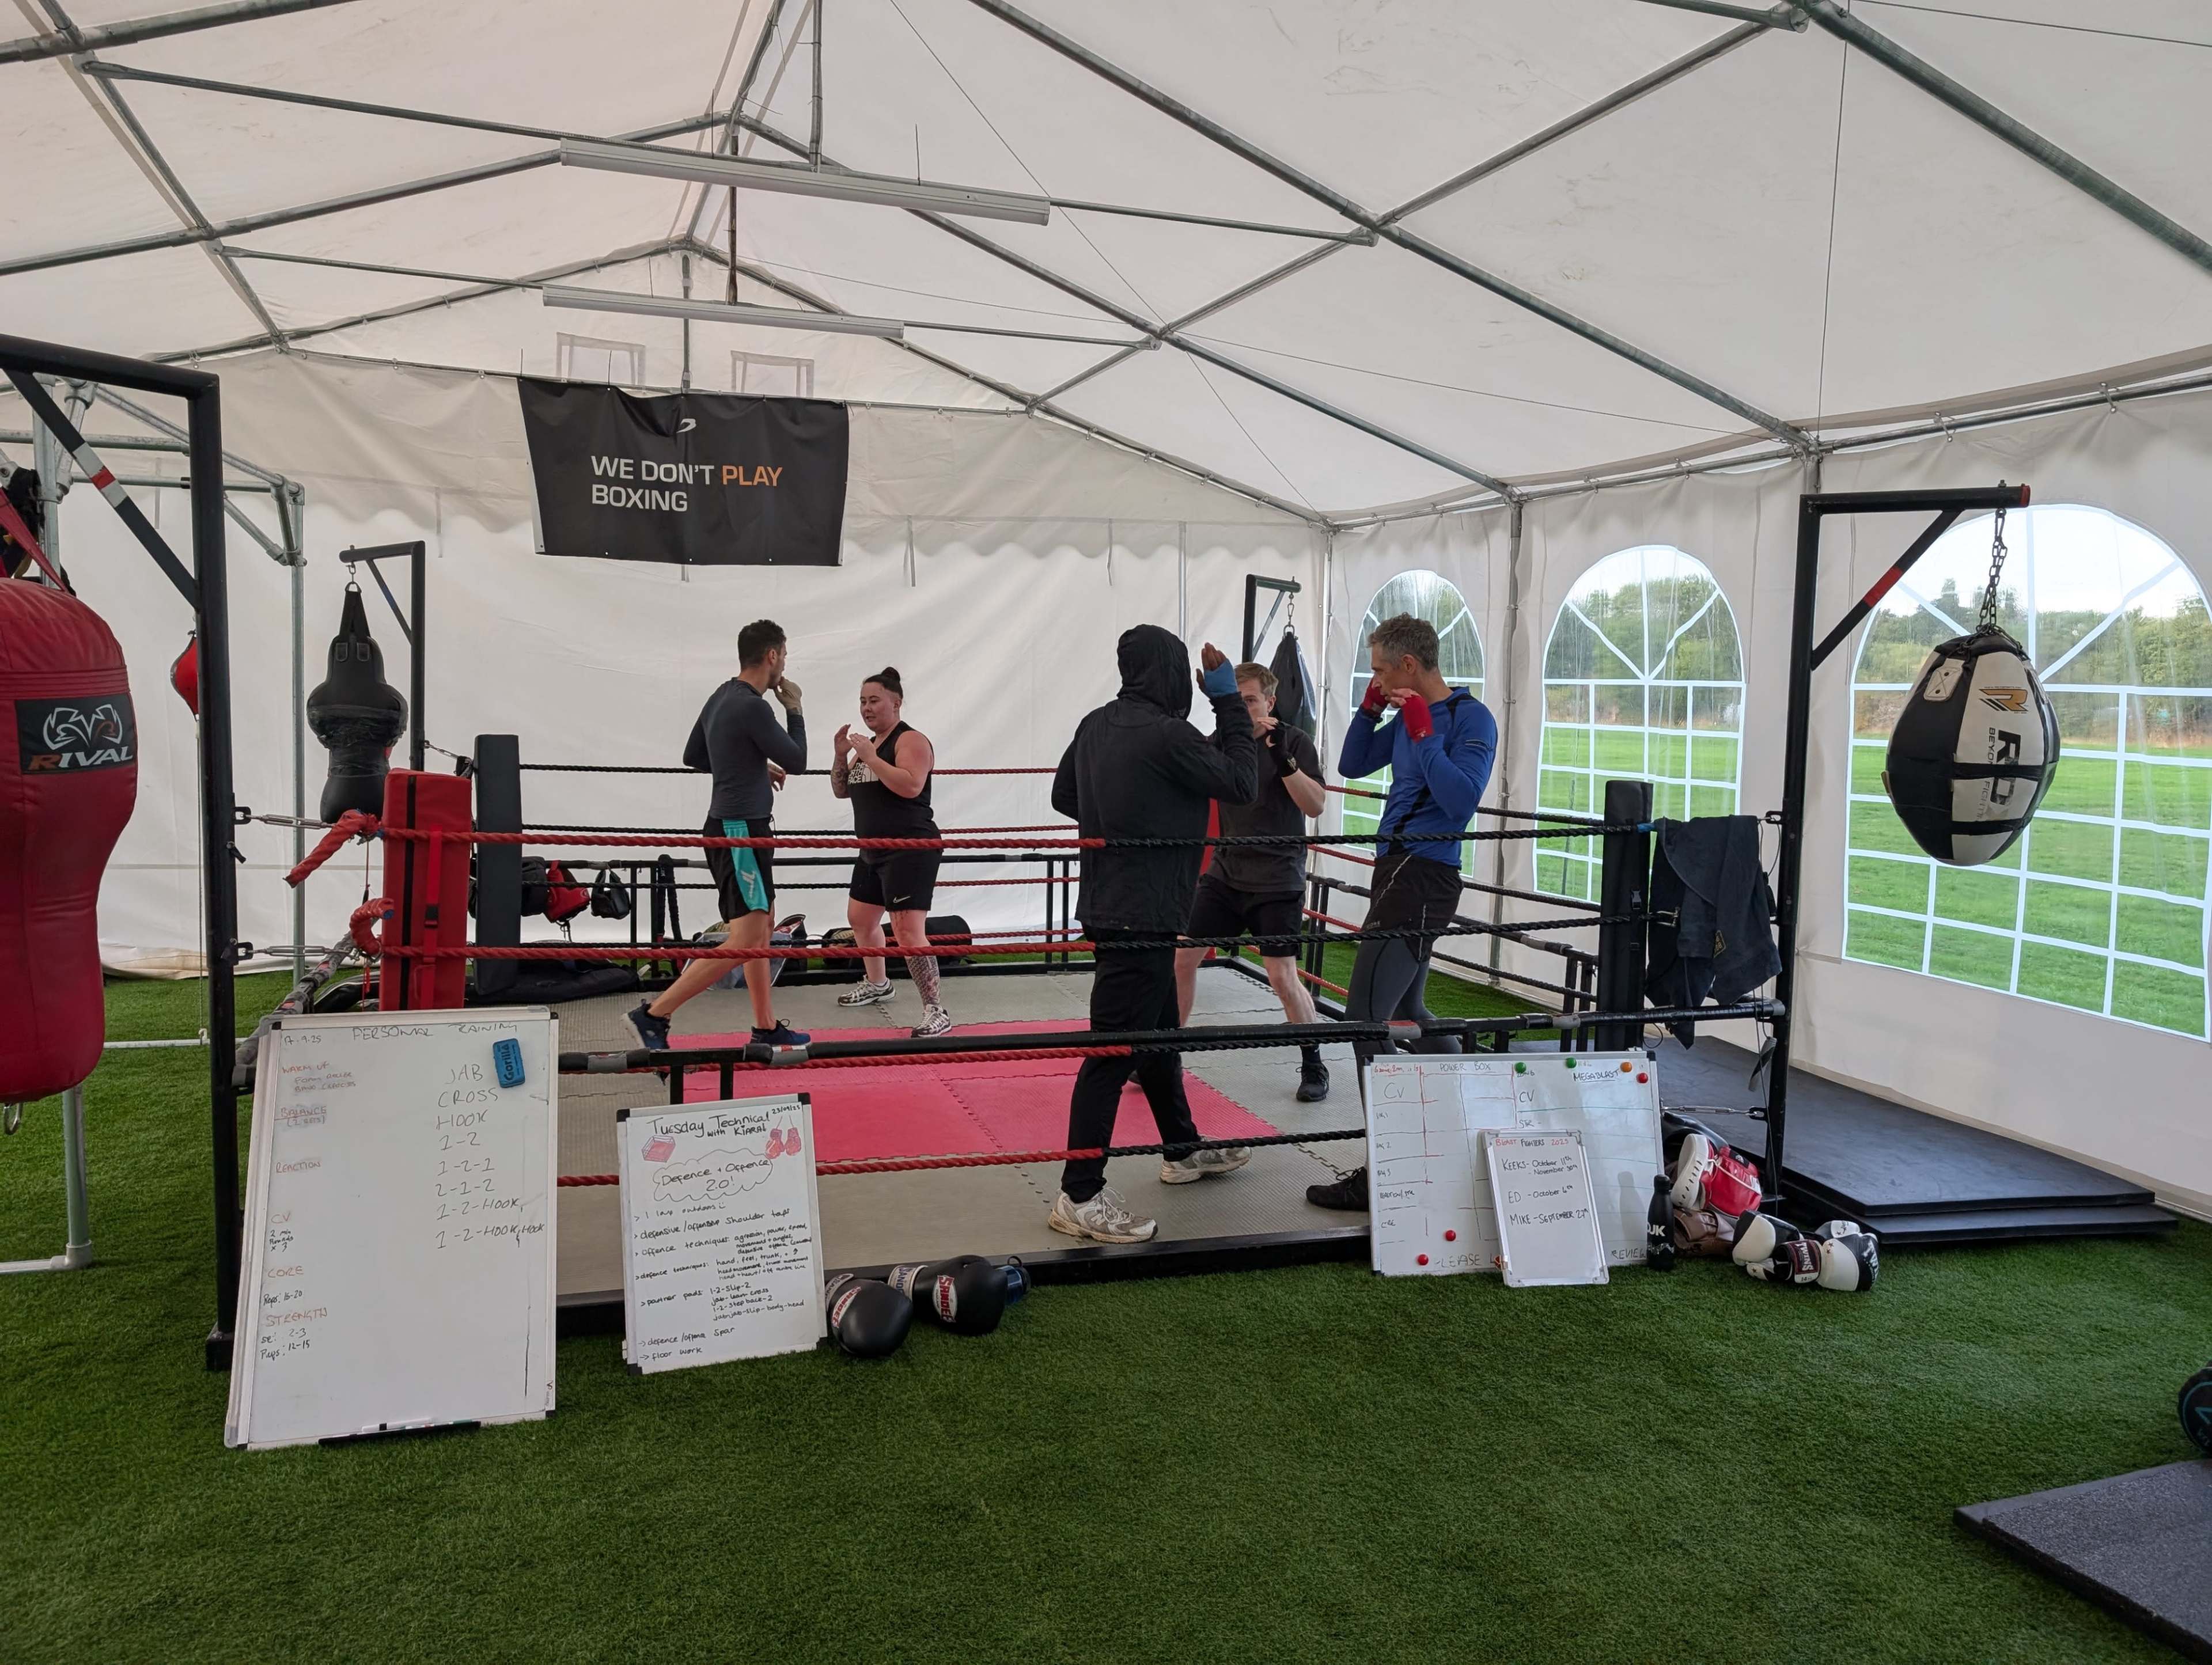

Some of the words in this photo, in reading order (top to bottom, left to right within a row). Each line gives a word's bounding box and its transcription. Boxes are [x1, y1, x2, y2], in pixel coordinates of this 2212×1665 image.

[590, 455, 634, 480] WE
[641, 460, 715, 486] DON'T
[721, 465, 783, 487] PLAY
[591, 483, 688, 512] BOXING
[28, 746, 134, 771] RIVAL
[501, 1043, 515, 1081] Gorilla
[1440, 1063, 1467, 1072] POWER
[1474, 1061, 1491, 1070] BOX
[444, 1064, 483, 1084] JAB
[1573, 1069, 1620, 1082] MEGABLAST
[438, 1087, 499, 1108] CROSS
[1384, 1082, 1405, 1099] CV
[1519, 1089, 1535, 1103] CV
[281, 1106, 327, 1117] BALANCE
[435, 1109, 488, 1131] HOOK
[646, 1117, 704, 1138] Tuesday
[709, 1112, 770, 1129] Technical
[707, 1128, 726, 1138] with
[439, 1132, 480, 1151] 1-2
[1521, 1138, 1545, 1147] FIGHTERS
[276, 1161, 321, 1173] REACTION
[437, 1158, 495, 1176] 1-2-1
[661, 1168, 713, 1186] Defence
[725, 1159, 771, 1173] Offence
[1533, 1167, 1564, 1175] November
[435, 1178, 495, 1197] 2-1-2
[1508, 1190, 1521, 1204] ED
[271, 1211, 291, 1224] CV
[1509, 1213, 1531, 1226] MIKE
[1794, 1242, 1814, 1272] TWINS
[267, 1265, 304, 1278] CORE
[266, 1307, 328, 1327] STRENGTH
[652, 1351, 673, 1361] floor
[679, 1347, 703, 1356] work
